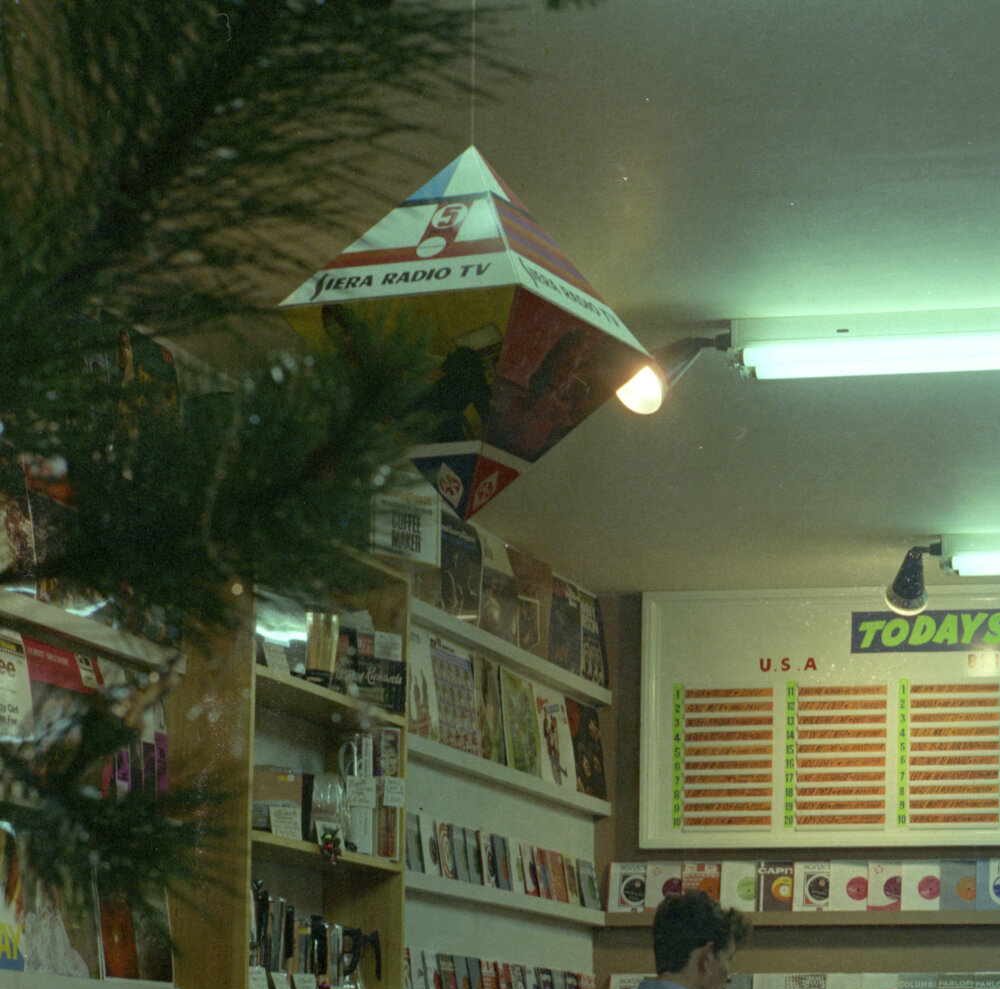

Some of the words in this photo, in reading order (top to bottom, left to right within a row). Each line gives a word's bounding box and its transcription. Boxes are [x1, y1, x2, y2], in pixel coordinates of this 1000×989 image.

[310, 273, 373, 301] SIERA
[381, 266, 452, 285] RADIO
[459, 262, 492, 278] TV
[788, 686, 794, 695] 11
[787, 701, 794, 710] 12
[787, 716, 794, 725] 13
[787, 730, 794, 739] 14
[786, 744, 794, 754] 15
[786, 758, 793, 768] 16
[786, 772, 793, 782] 17
[786, 787, 793, 796] 18
[785, 802, 793, 811] 19
[673, 817, 681, 825] 10
[784, 815, 793, 824] 20
[898, 814, 906, 823] 10
